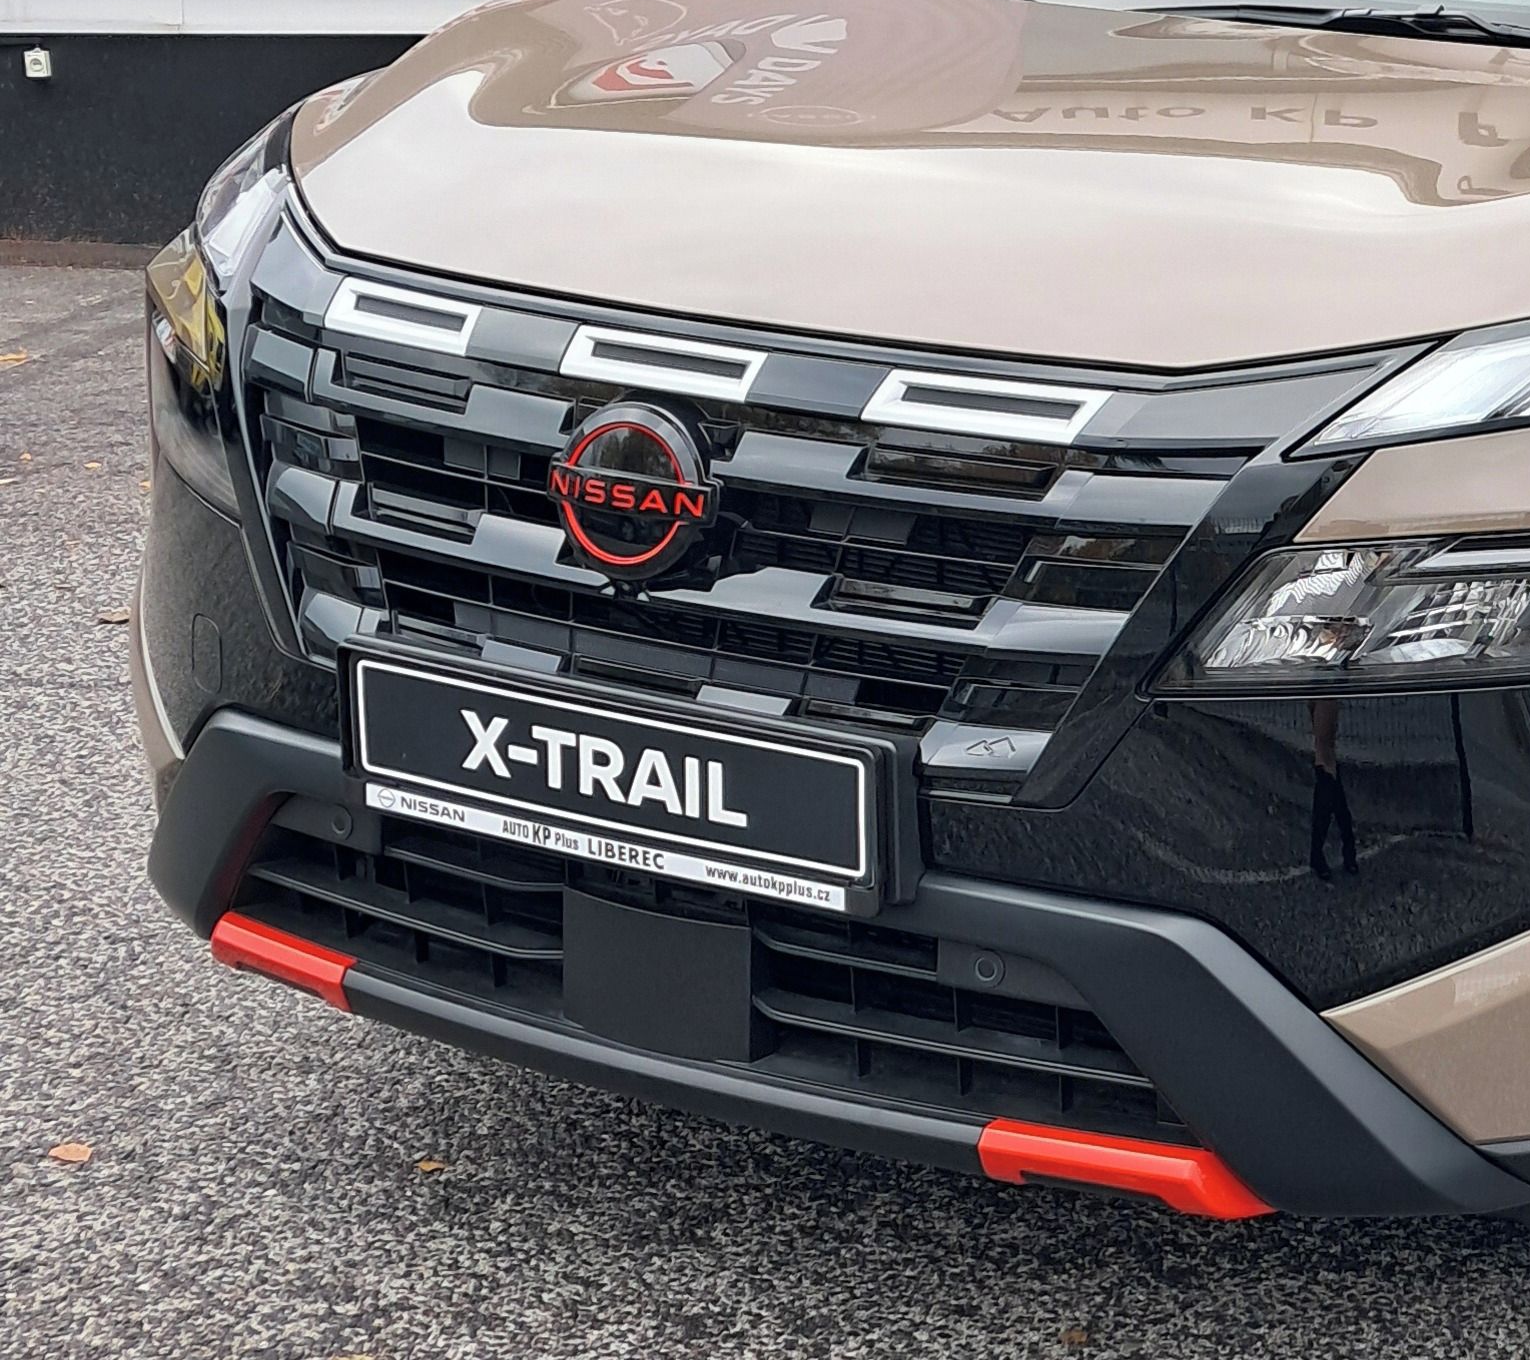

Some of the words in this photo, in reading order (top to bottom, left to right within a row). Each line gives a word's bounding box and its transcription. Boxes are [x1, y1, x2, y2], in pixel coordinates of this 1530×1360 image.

[550, 468, 705, 518] NISSAN
[459, 708, 749, 829] X-TRAIL
[400, 796, 466, 823] NISSAN
[502, 819, 530, 839] AUTO
[532, 823, 551, 846] KP
[554, 832, 580, 851] Plus
[587, 838, 665, 870] LIBEREC
[704, 864, 831, 903] www.autokpplus.cz
